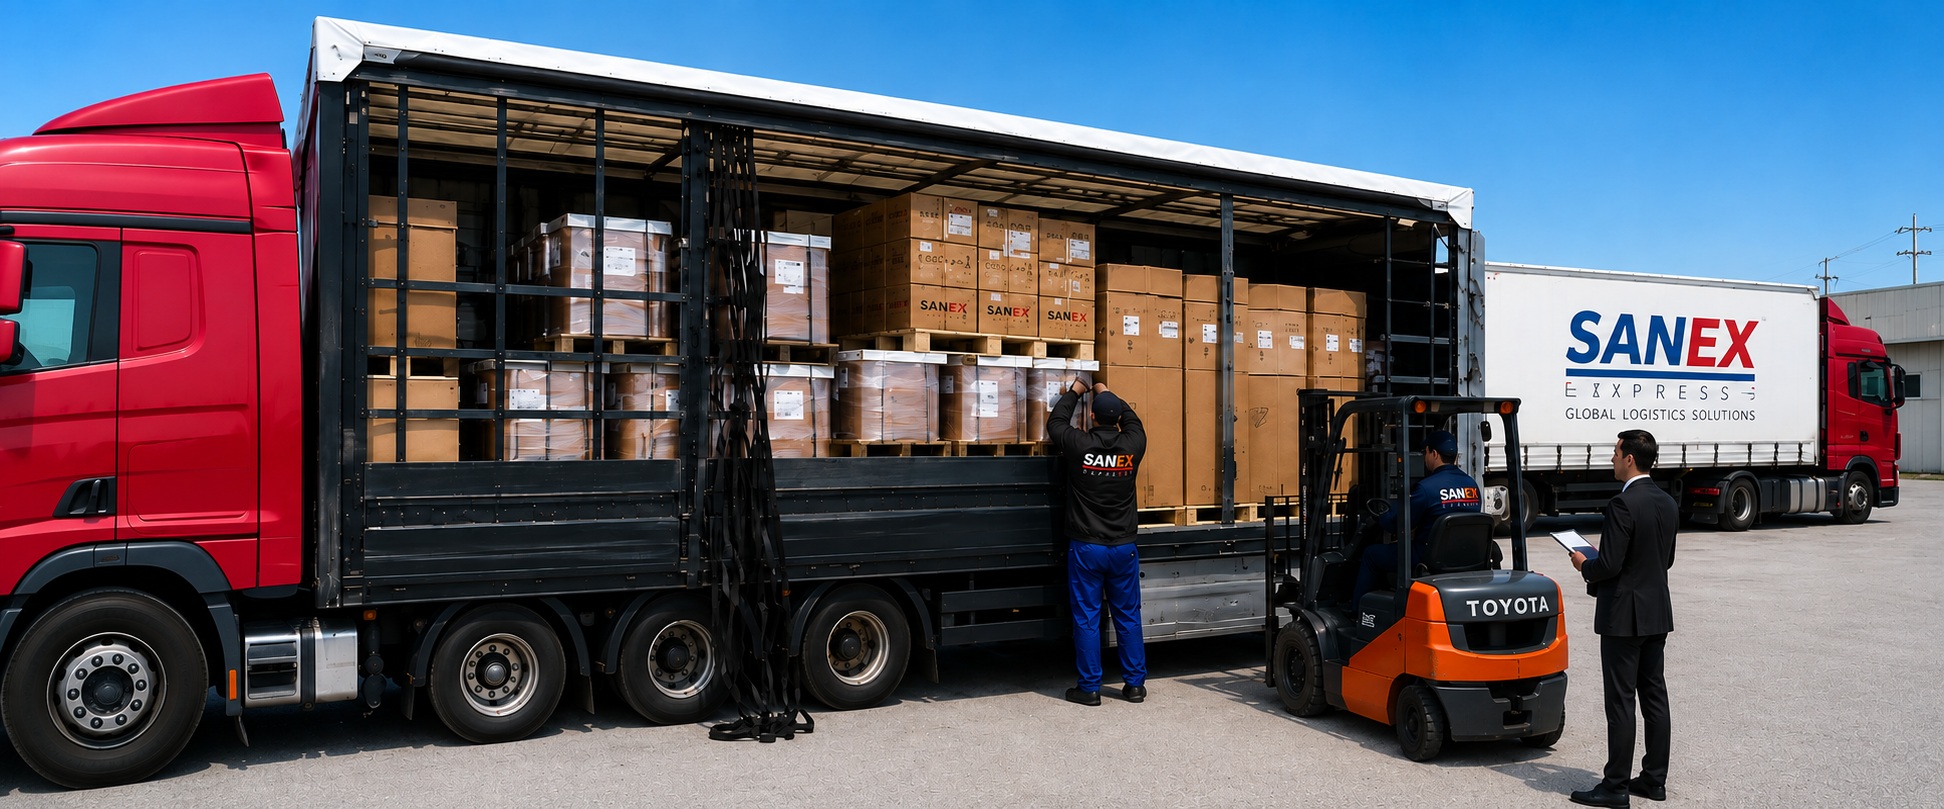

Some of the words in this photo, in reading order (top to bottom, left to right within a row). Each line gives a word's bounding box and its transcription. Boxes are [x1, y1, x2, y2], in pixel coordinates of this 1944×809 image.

[920, 300, 967, 314] SANEX
[987, 305, 1030, 318] SANEX
[1047, 311, 1087, 322] SANEX
[1565, 310, 1759, 368] SANEX
[1565, 407, 1616, 420] GLOBAL
[1622, 408, 1686, 421] LOGISTICS
[1692, 409, 1755, 421] SOLUTIONS
[1083, 453, 1134, 467] SANEX
[1440, 487, 1478, 500] SANEX
[1466, 596, 1549, 616] TOYOTA
